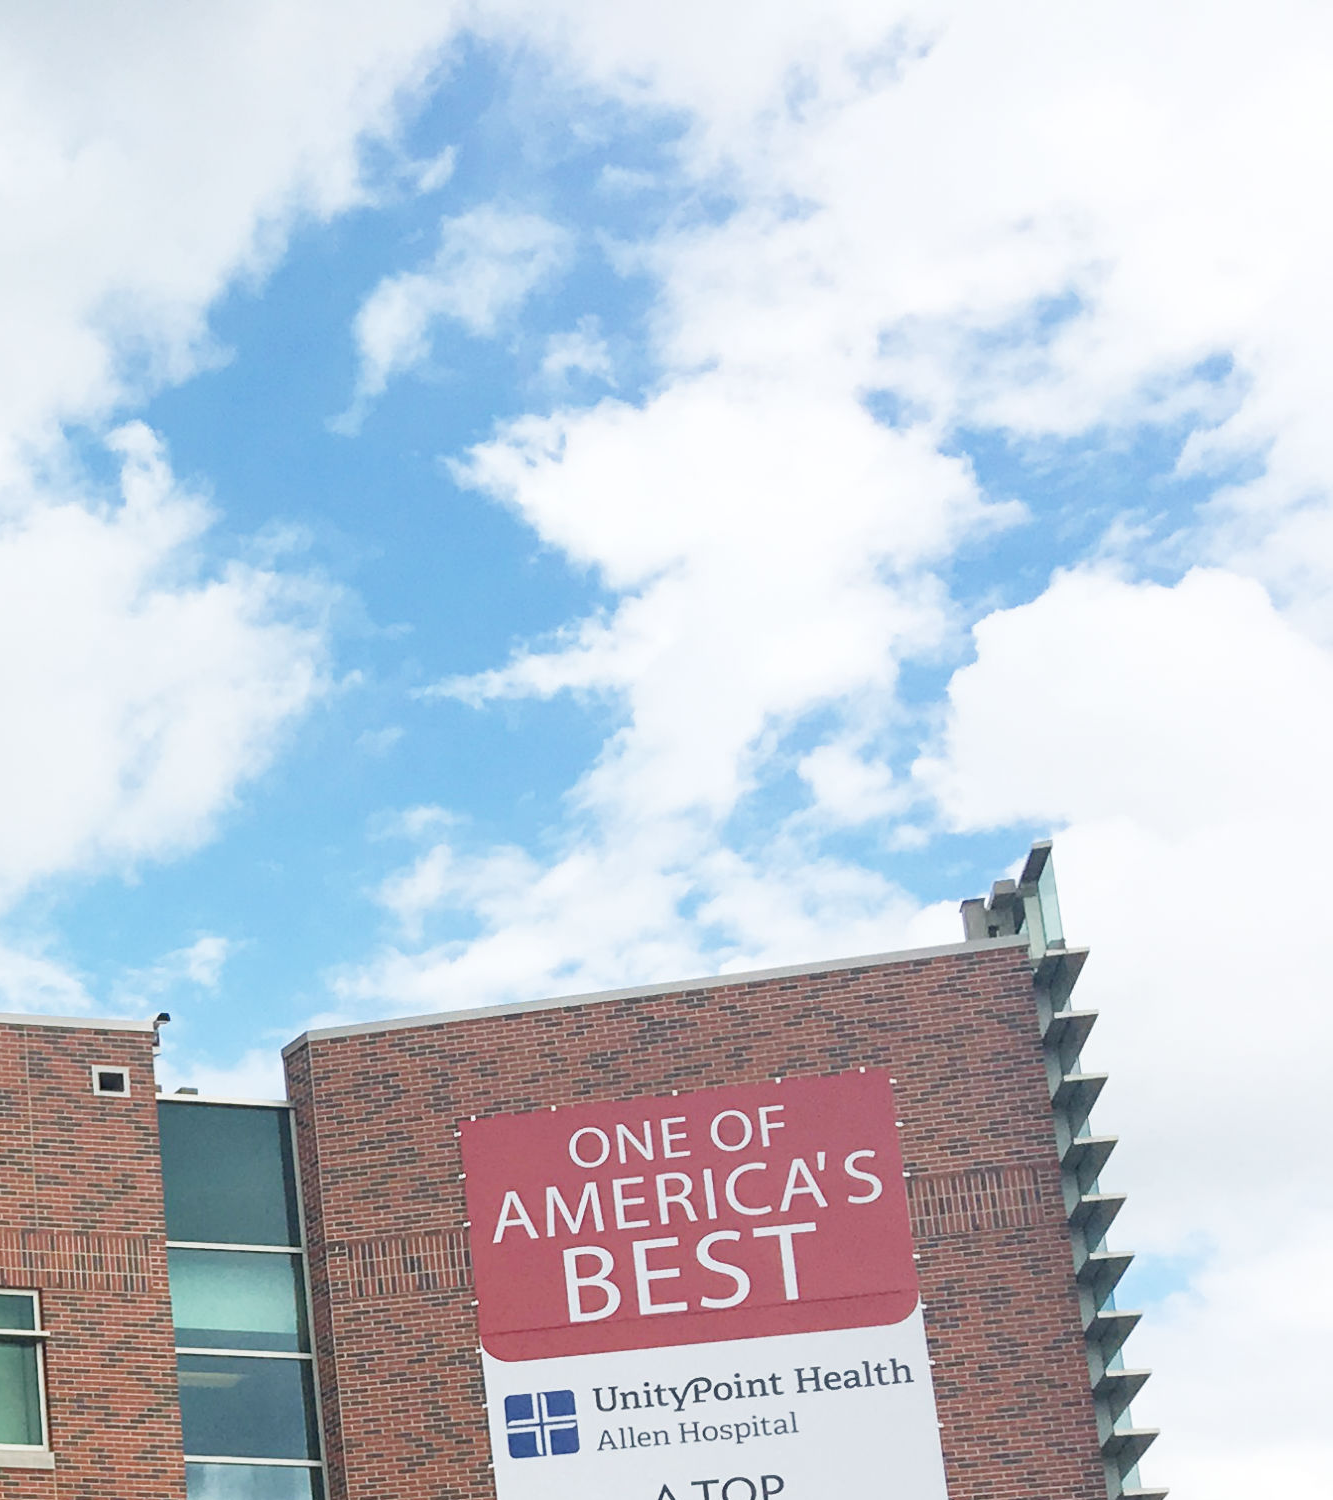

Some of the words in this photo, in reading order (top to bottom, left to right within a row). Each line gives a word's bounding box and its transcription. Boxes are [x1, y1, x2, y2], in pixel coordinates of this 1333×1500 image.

[568, 1116, 691, 1169] ONE
[710, 1105, 785, 1152] OF
[492, 1150, 883, 1243] AMERICA'S
[562, 1222, 817, 1323] BEST
[592, 1372, 785, 1412] UnityPoint
[795, 1358, 915, 1394] Health
[597, 1426, 670, 1451] Allen
[679, 1411, 799, 1446] Hospital
